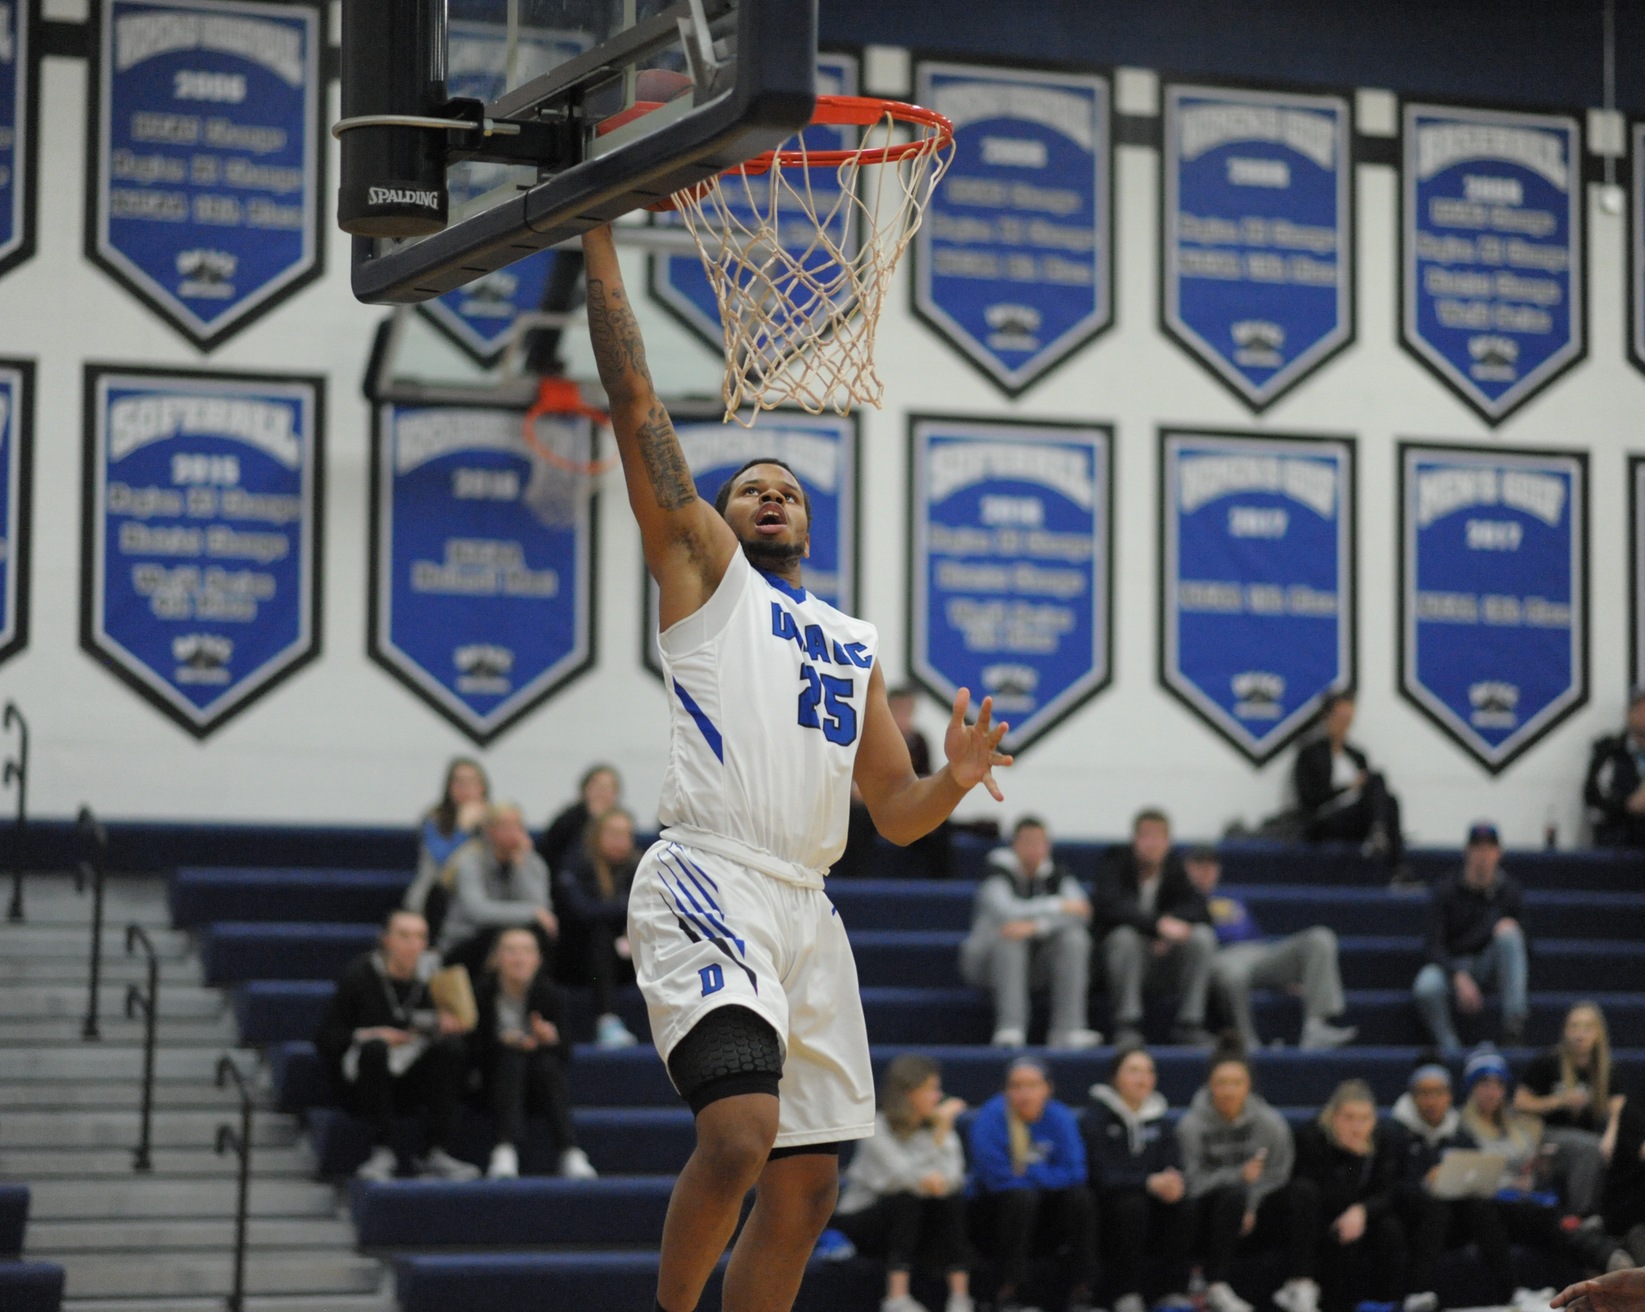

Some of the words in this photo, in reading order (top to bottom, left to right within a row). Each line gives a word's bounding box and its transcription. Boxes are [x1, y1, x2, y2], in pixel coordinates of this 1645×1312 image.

[368, 187, 439, 210] SPALDING
[798, 662, 857, 747] 25
[698, 963, 724, 998] D
